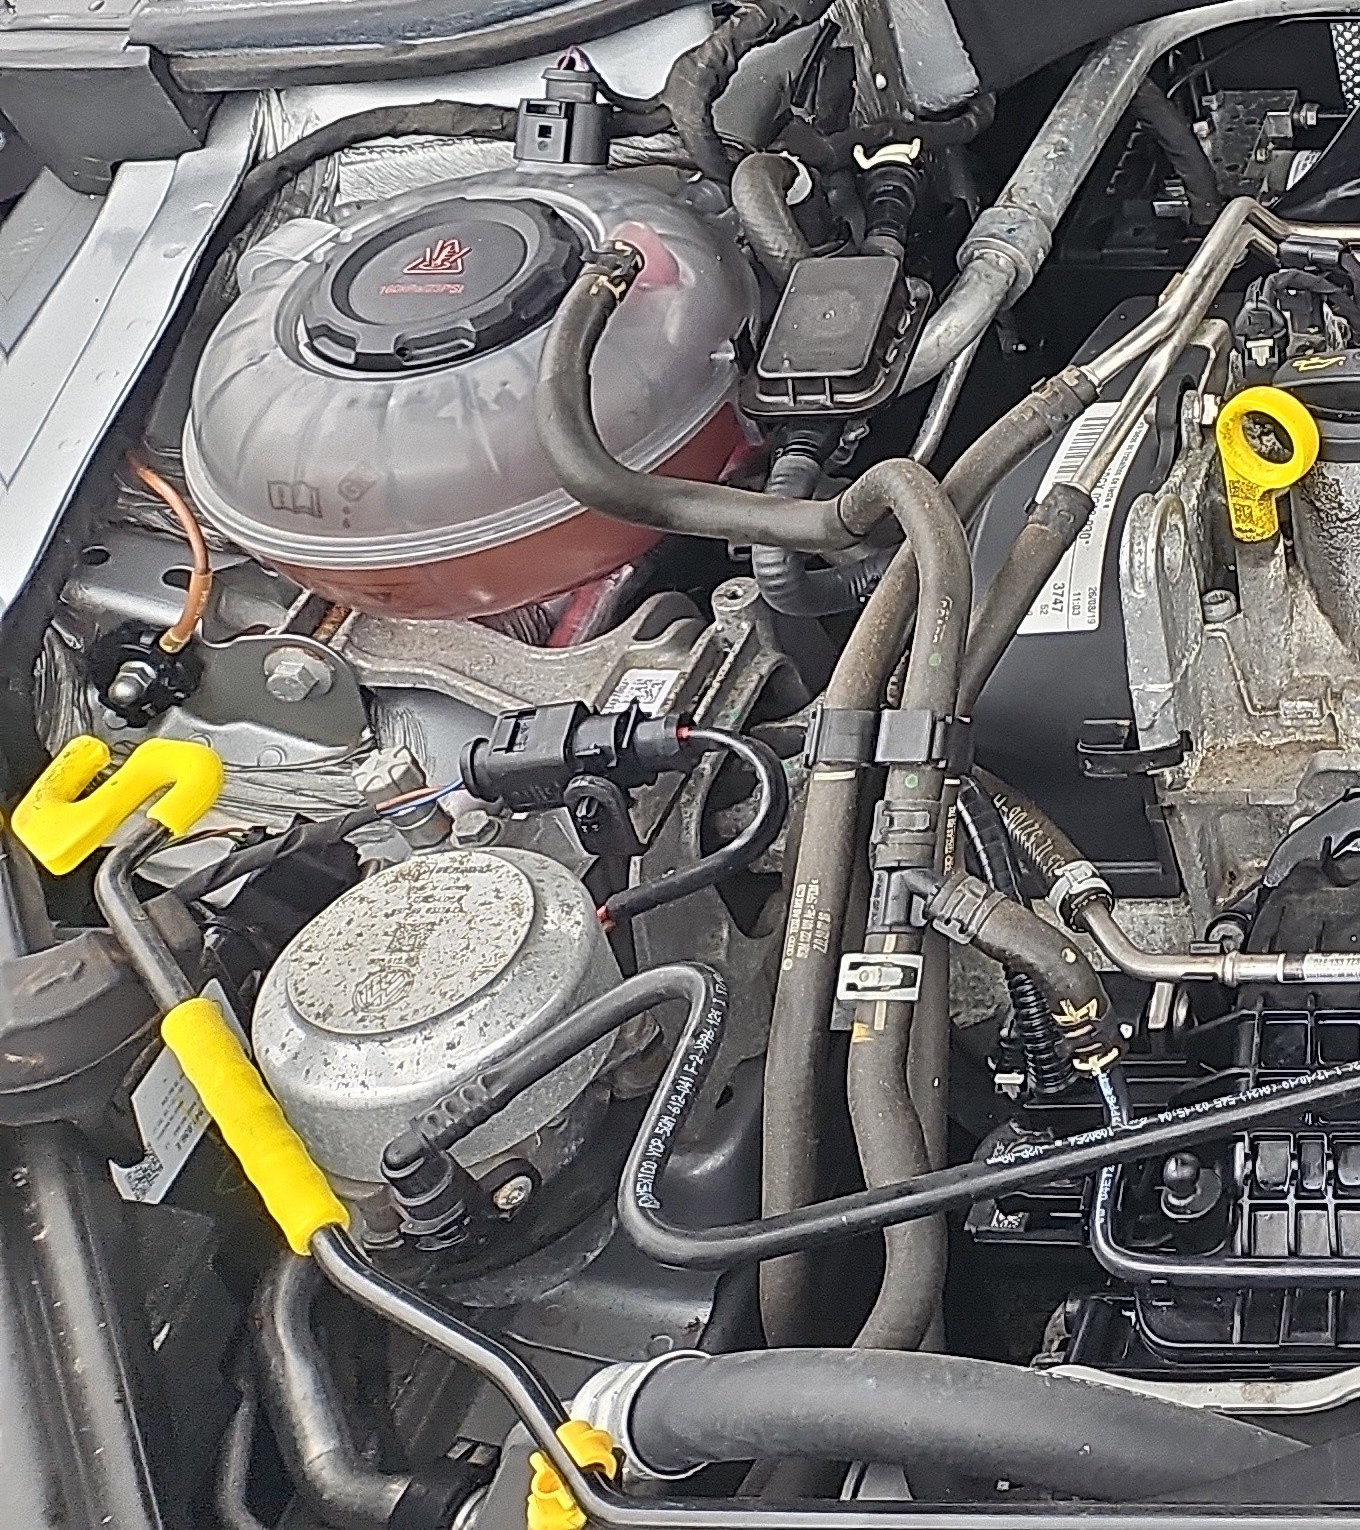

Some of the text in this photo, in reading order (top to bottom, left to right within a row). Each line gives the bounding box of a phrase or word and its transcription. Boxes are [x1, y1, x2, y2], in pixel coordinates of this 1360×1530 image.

[1052, 582, 1064, 612] 3747
[1072, 592, 1080, 615] 11:03
[1040, 604, 1048, 614] 52
